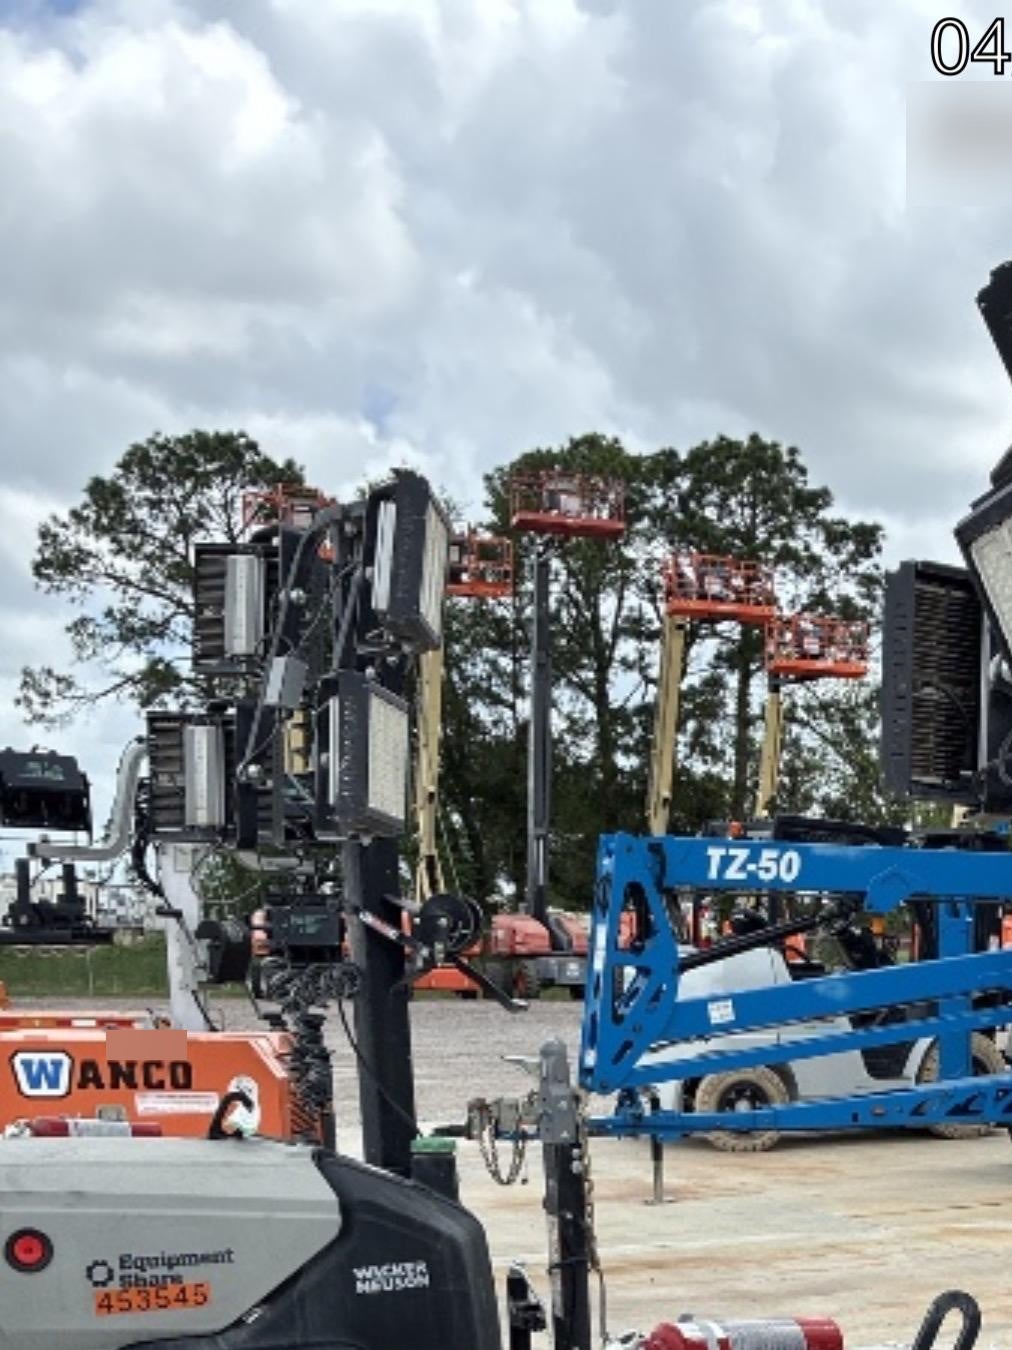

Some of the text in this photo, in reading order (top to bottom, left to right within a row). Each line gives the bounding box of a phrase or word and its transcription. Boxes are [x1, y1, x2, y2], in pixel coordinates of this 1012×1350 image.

[706, 846, 801, 882] TZ-50
[19, 1059, 193, 1089] WANCO
[119, 1248, 234, 1272] Equipment
[119, 1273, 183, 1289] Share
[98, 1283, 208, 1314] 453545
